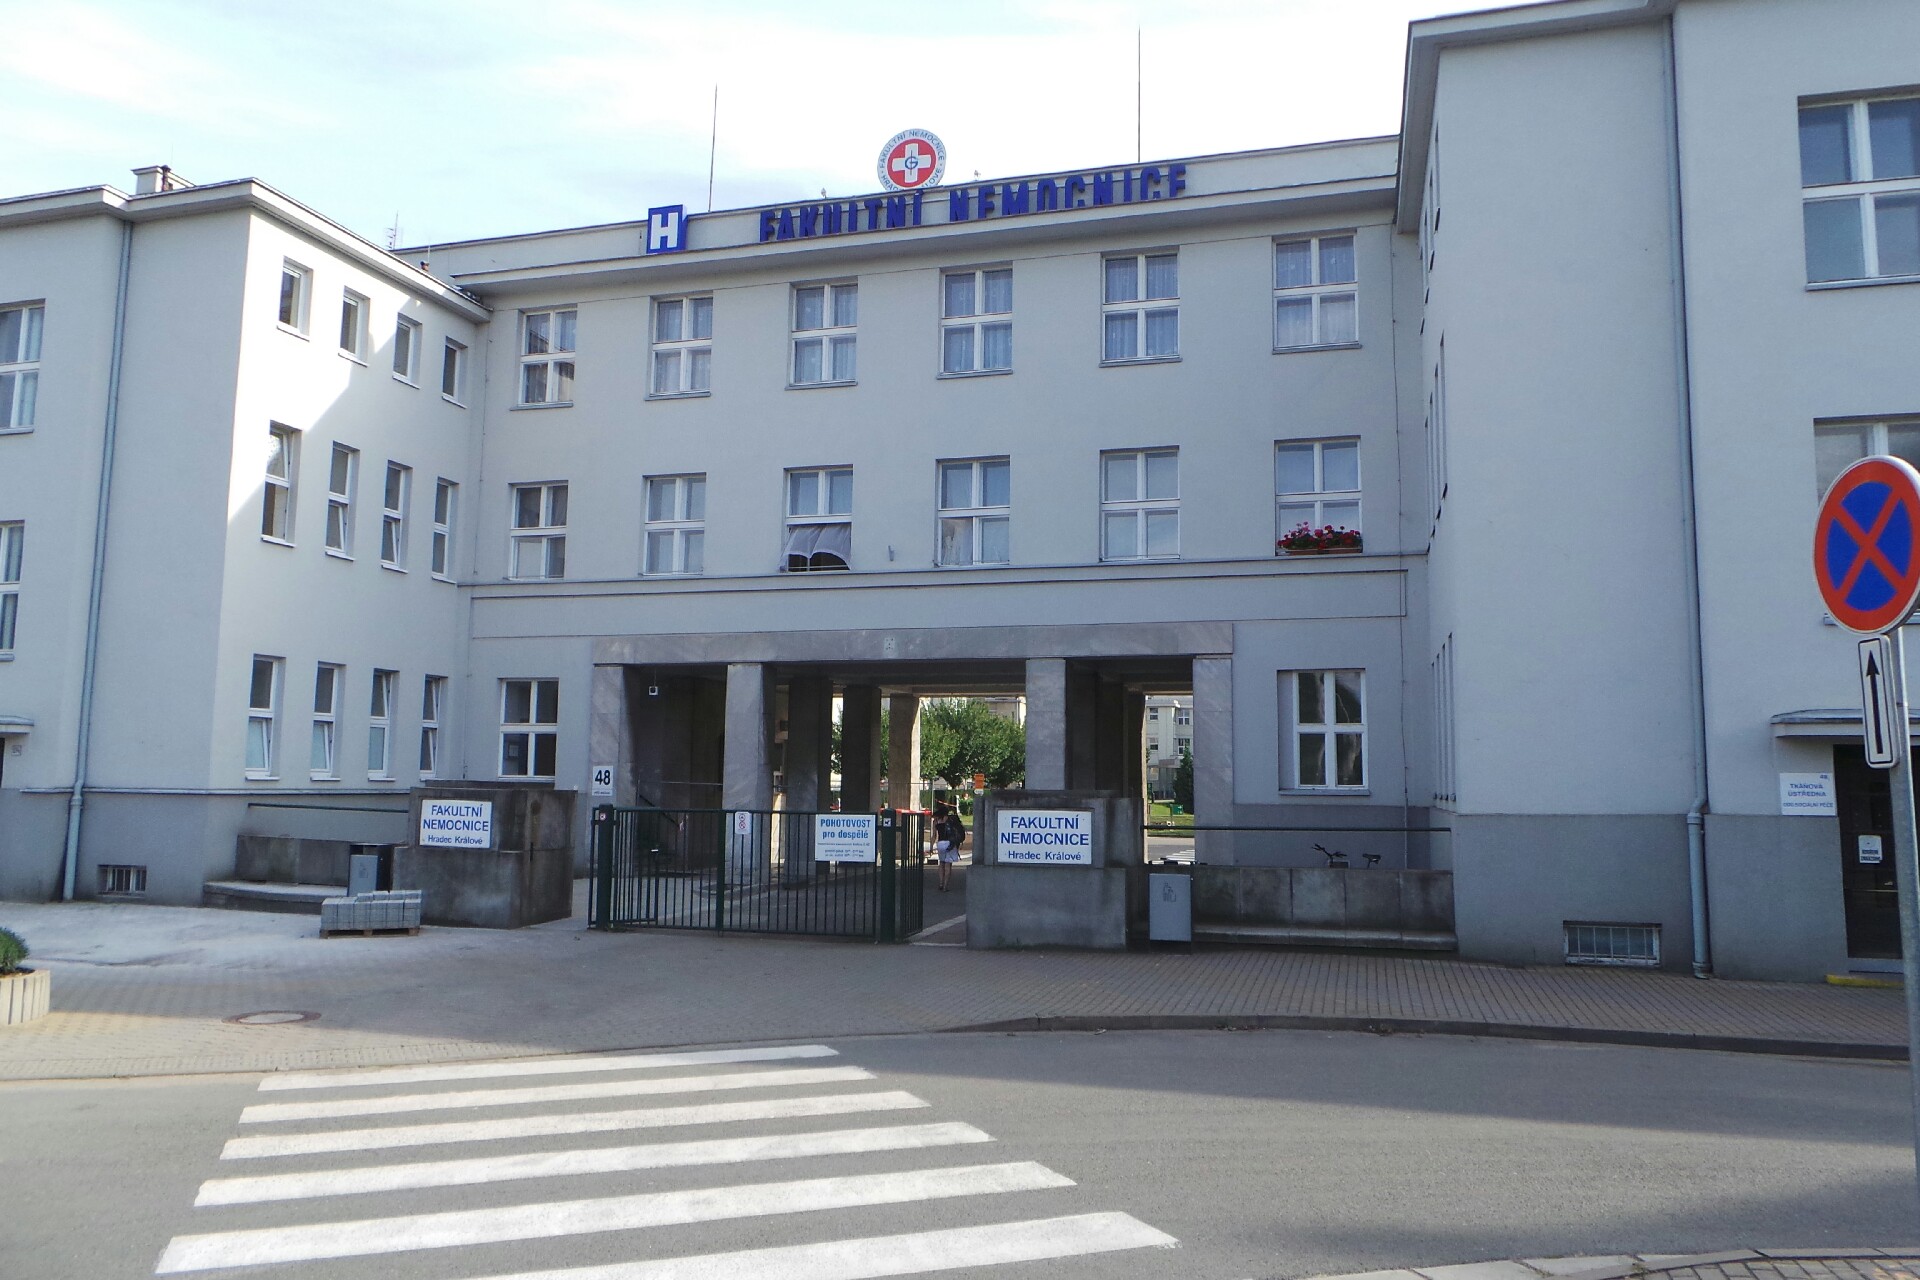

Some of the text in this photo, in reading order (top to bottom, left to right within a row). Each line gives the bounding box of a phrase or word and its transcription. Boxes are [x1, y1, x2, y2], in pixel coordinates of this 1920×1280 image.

[909, 130, 945, 161] NEMOCNICE
[950, 163, 1187, 222] NEMOCNICE
[650, 212, 679, 250] H
[594, 769, 611, 786] 48
[431, 803, 484, 817] FAKULTNÍ
[423, 818, 489, 832] NEMOCNICE
[820, 818, 871, 828] POHOTOVOST
[1010, 814, 1079, 830] FAKULTNÍ
[427, 834, 483, 845] Hradec Králové
[822, 829, 869, 841] pro dospělé
[1000, 832, 1089, 846] NEMOCNICE
[1008, 850, 1082, 861] Hradec Králové
